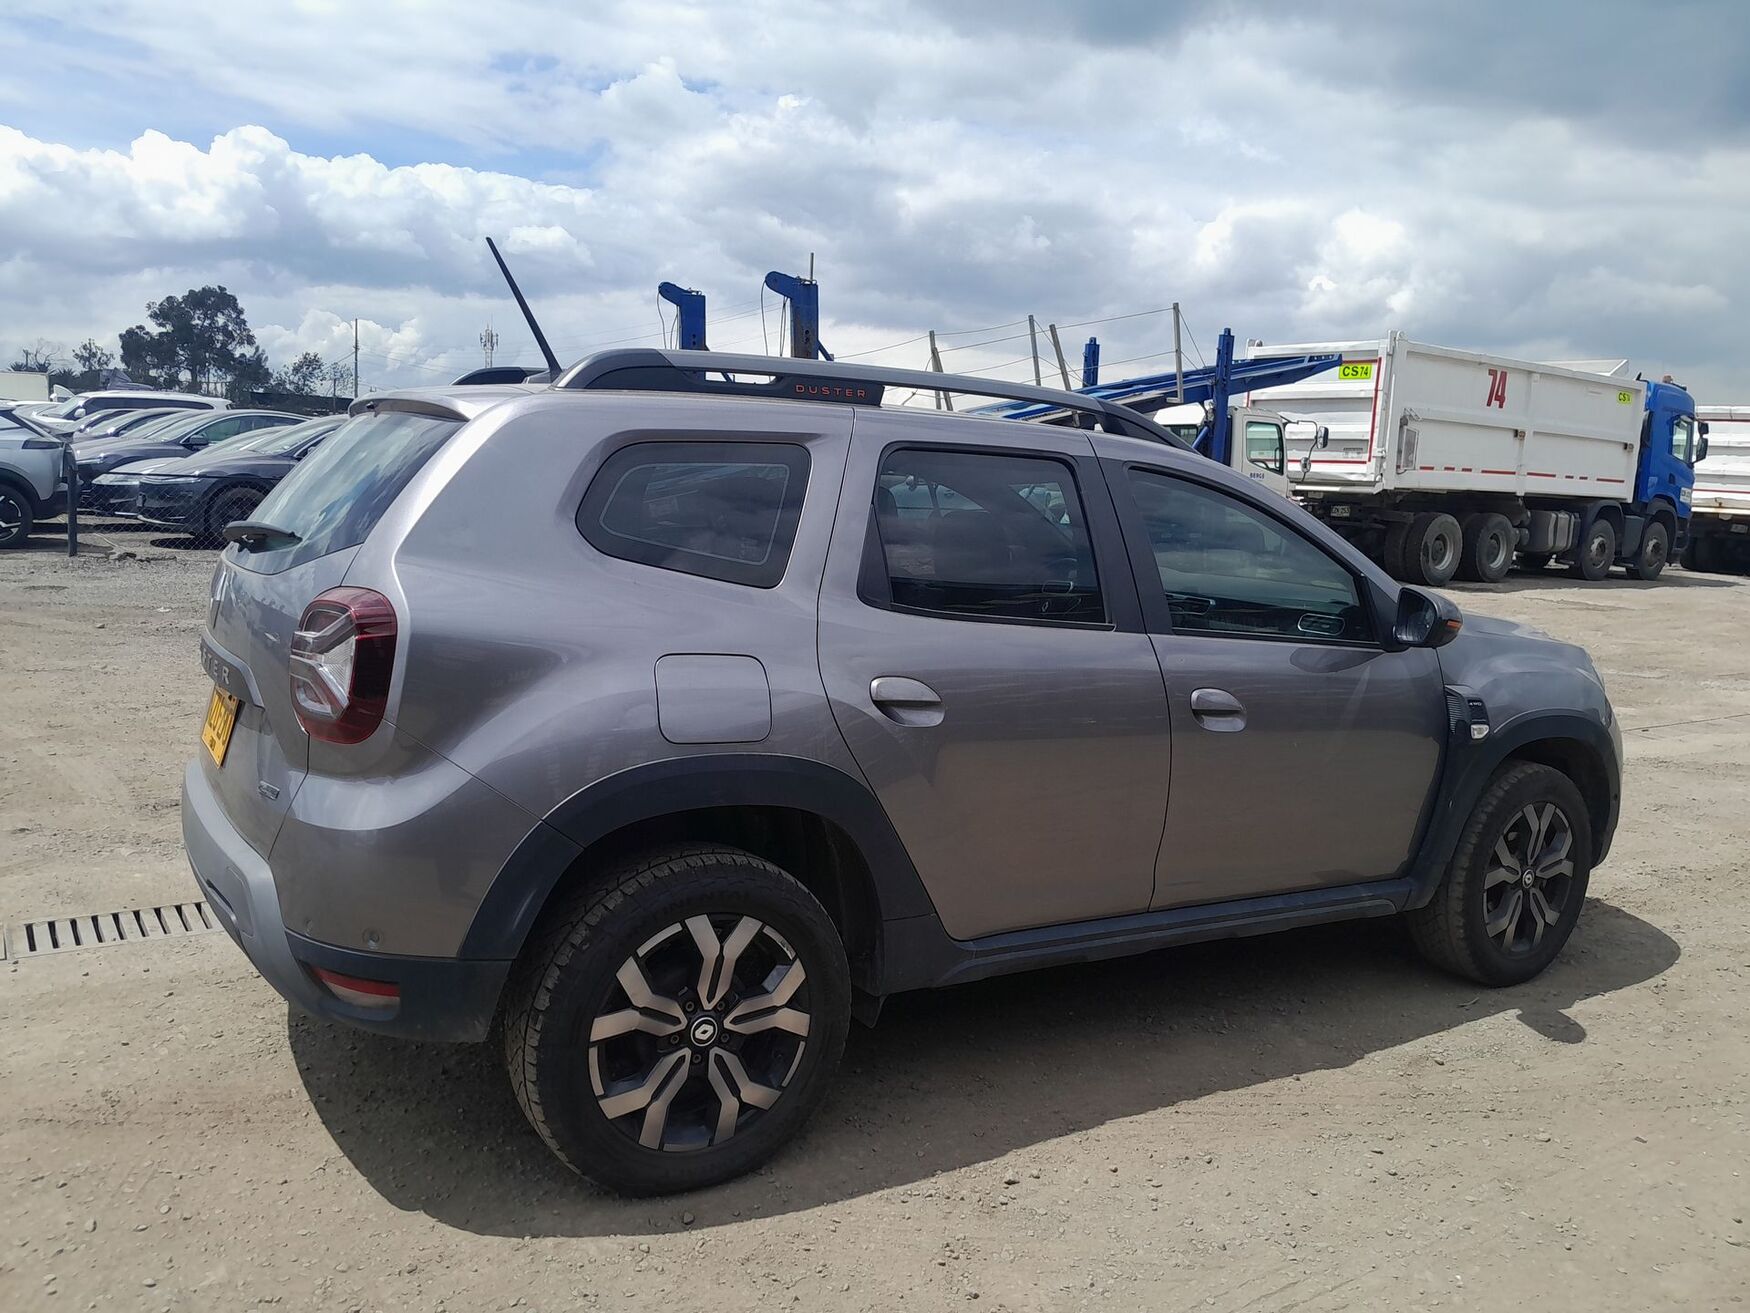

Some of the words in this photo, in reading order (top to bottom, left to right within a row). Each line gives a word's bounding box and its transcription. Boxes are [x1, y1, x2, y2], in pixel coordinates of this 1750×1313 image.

[1343, 366, 1369, 377] CS74
[796, 384, 866, 398] DUSTER
[1487, 369, 1507, 409] 74
